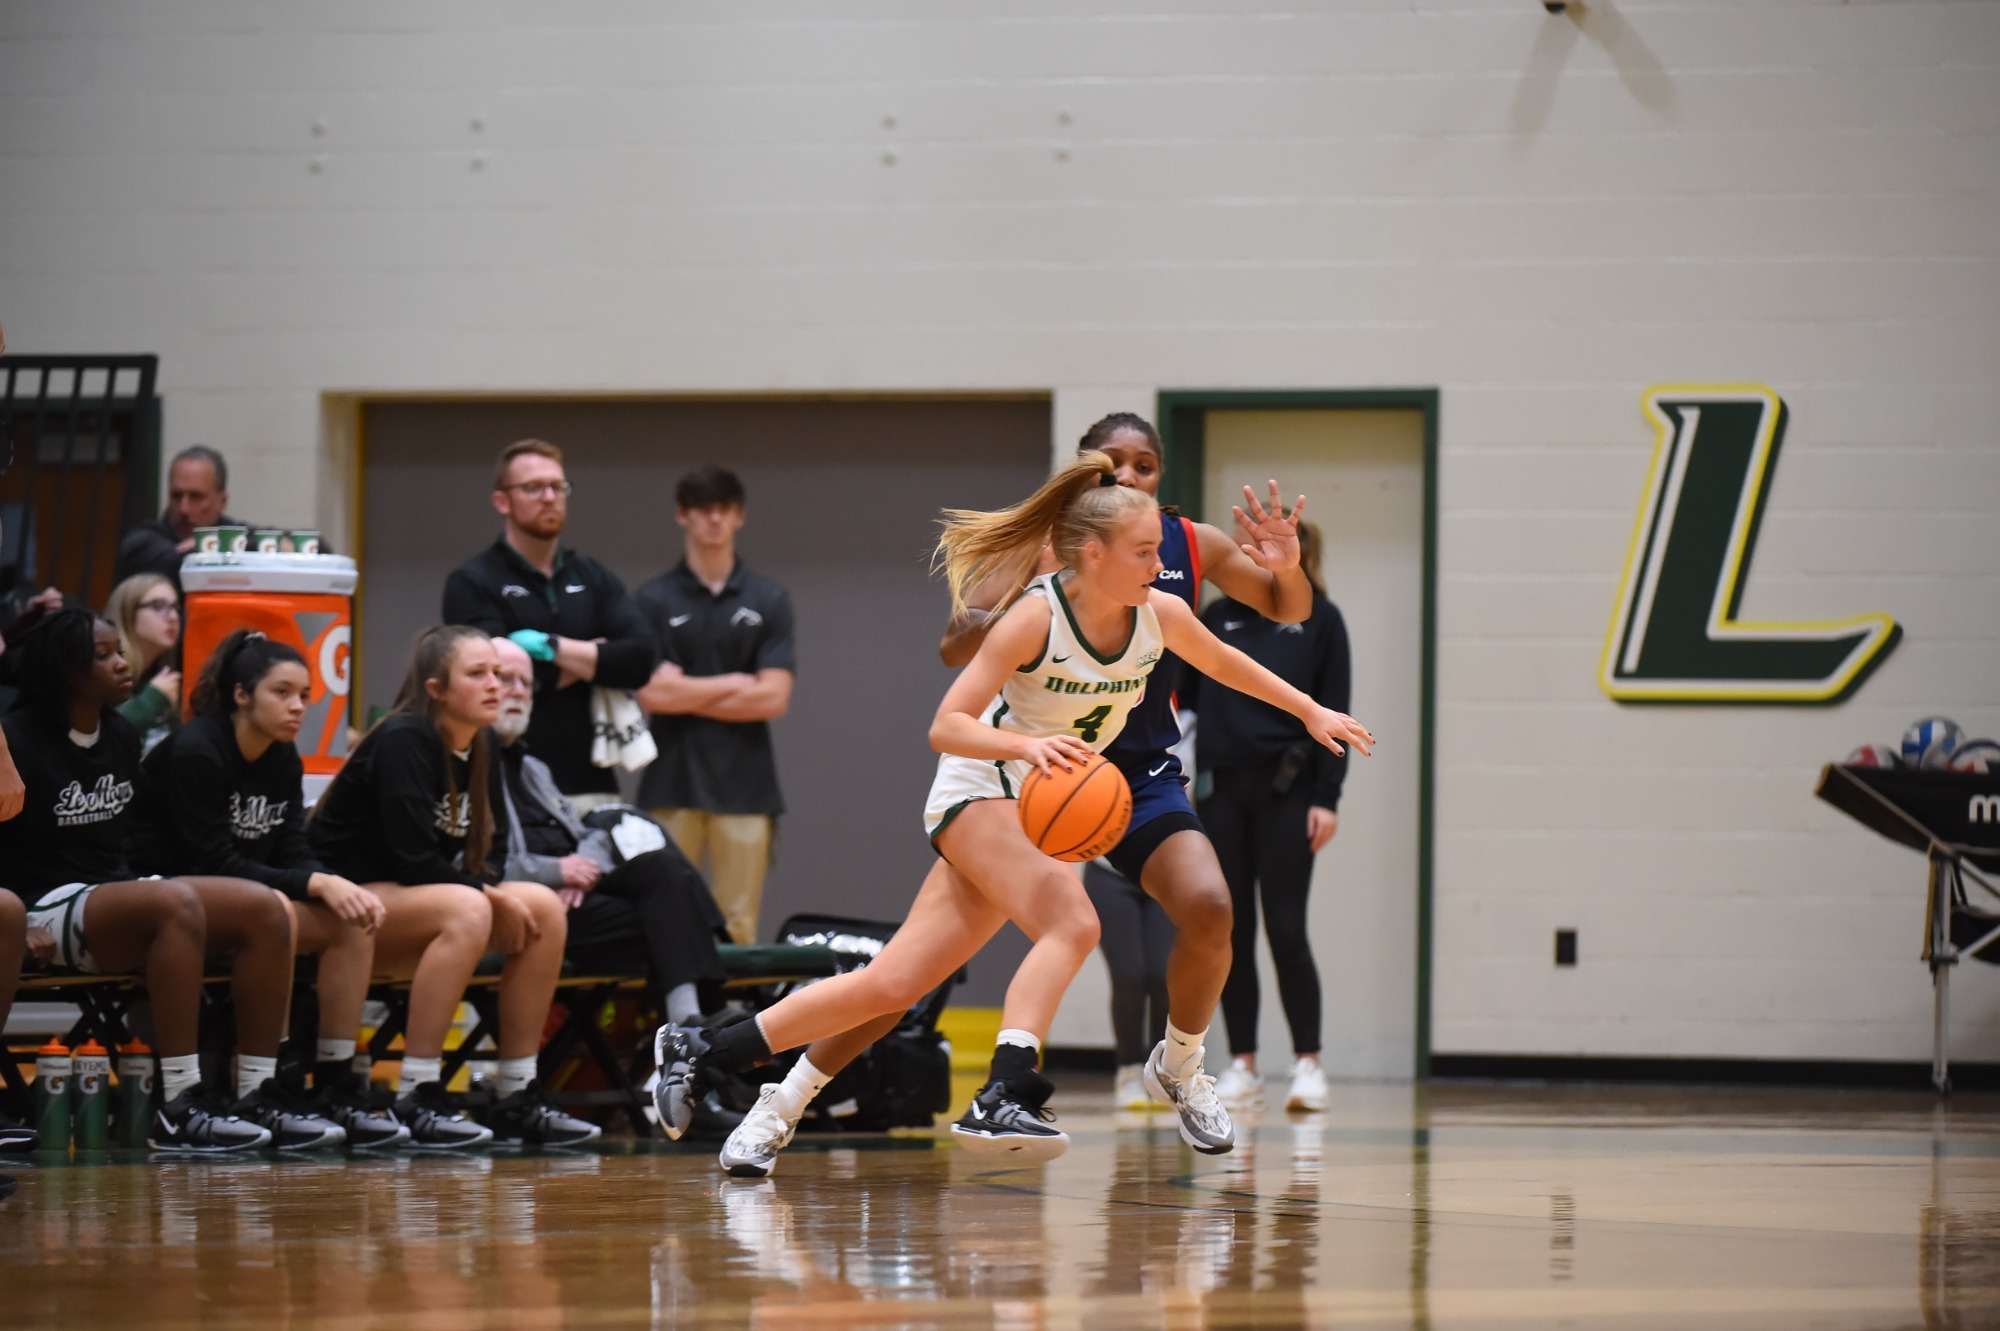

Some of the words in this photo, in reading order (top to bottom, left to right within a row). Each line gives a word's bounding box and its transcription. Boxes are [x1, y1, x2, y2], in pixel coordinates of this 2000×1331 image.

[1600, 382, 1903, 706] L
[1158, 569, 1185, 580] CAA
[319, 624, 351, 696] G
[1072, 704, 1114, 743] 4
[44, 1074, 65, 1095] G
[79, 1073, 99, 1095] G
